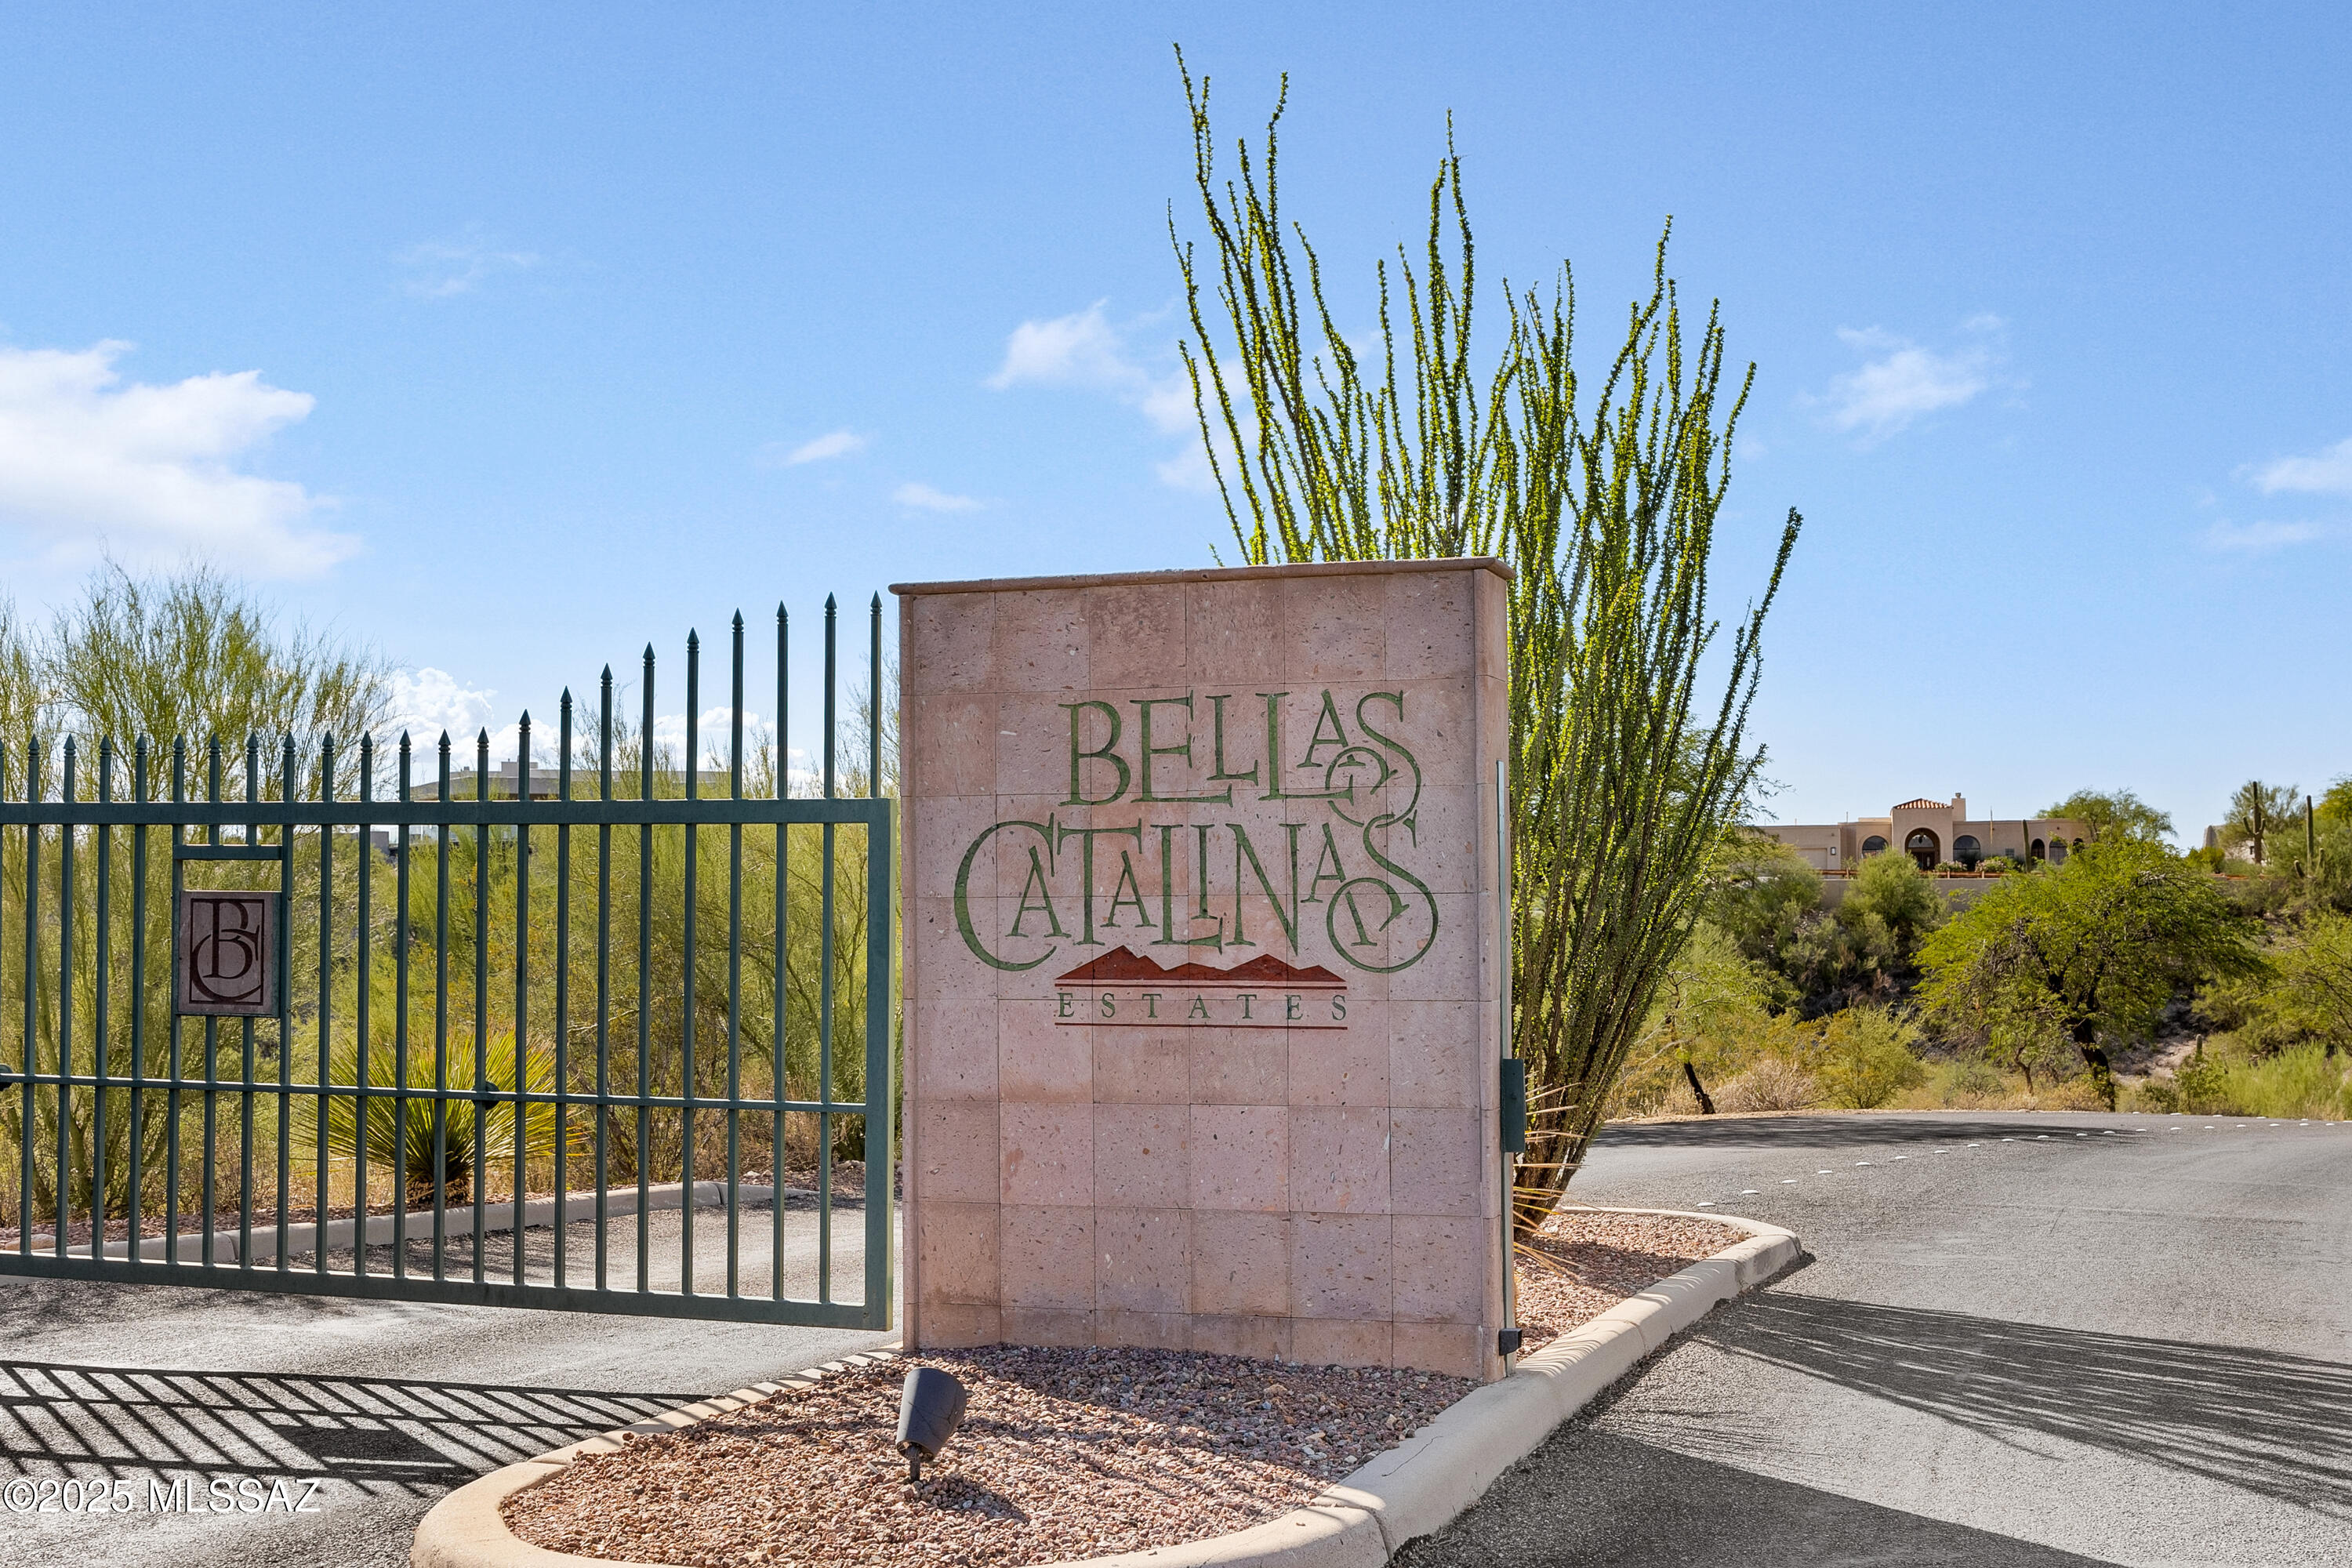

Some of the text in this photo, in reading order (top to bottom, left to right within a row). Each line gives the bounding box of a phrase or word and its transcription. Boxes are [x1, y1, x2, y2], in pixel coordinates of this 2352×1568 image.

[1058, 688, 1422, 827] BELLAS
[953, 808, 1439, 974] CATALINAS
[1056, 991, 1348, 1020] ESTATES
